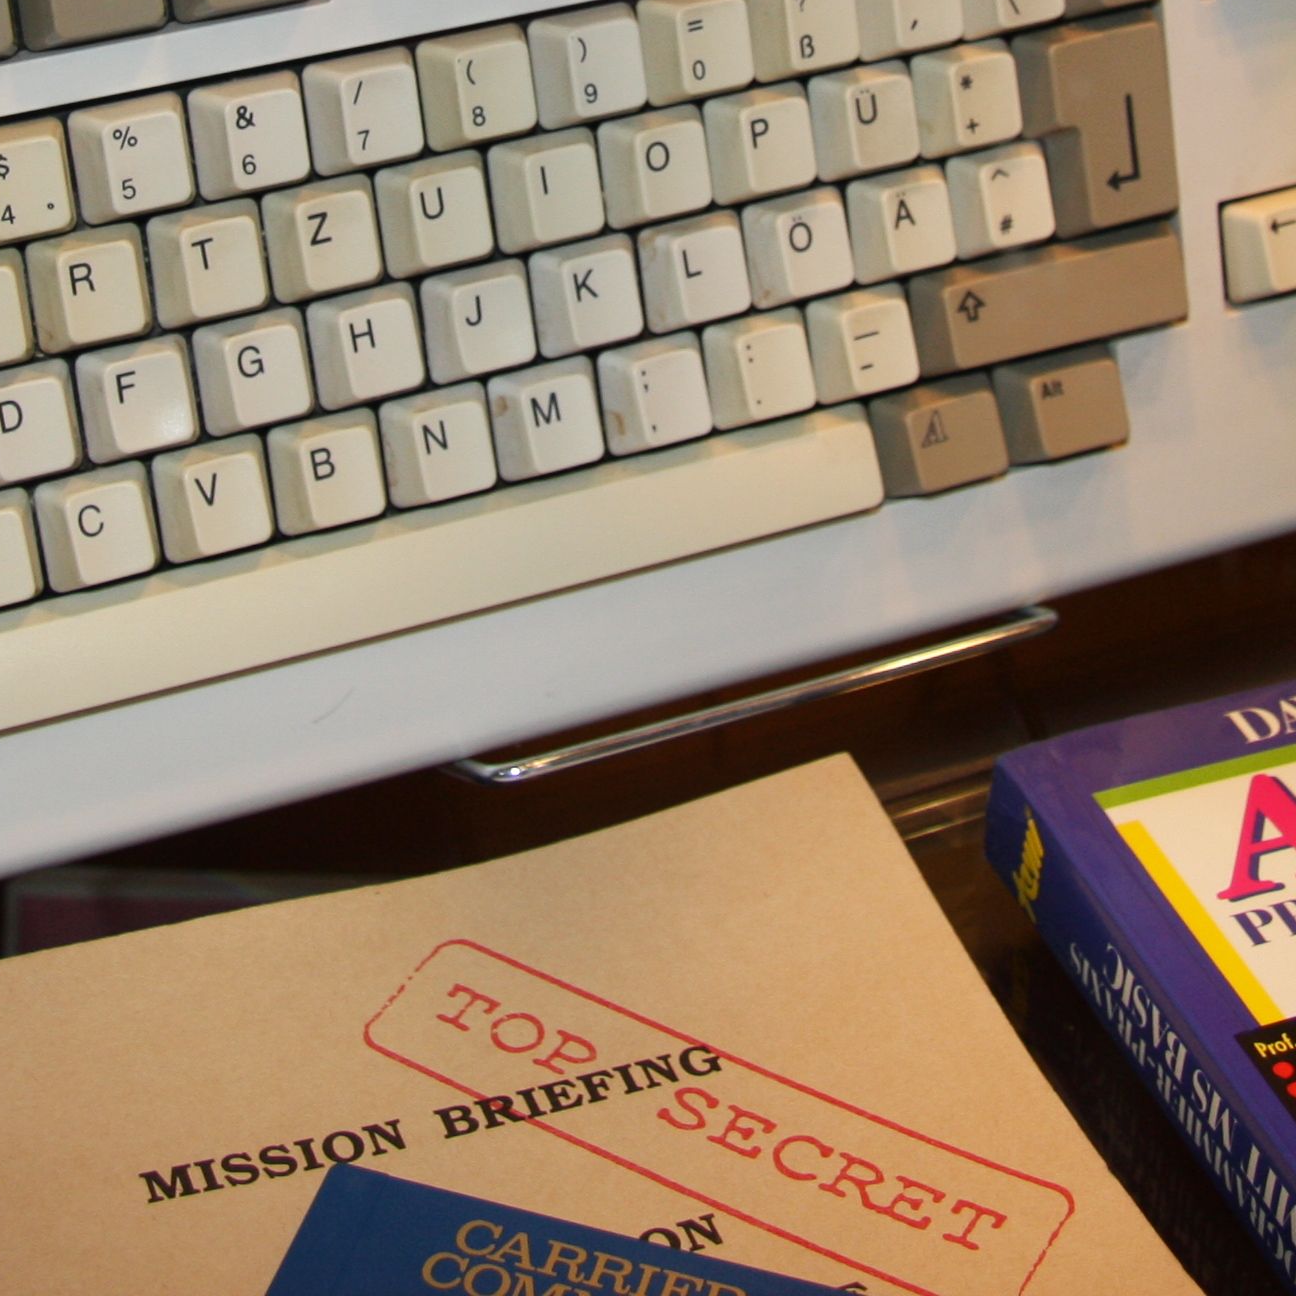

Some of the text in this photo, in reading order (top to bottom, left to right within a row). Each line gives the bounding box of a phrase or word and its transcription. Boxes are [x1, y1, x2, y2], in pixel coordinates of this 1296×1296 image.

[799, 35, 815, 59] ß
[692, 59, 706, 81] 0
[584, 83, 599, 104] 9
[855, 89, 878, 125] Ü
[472, 106, 487, 127] 8
[357, 129, 371, 152] 7
[750, 118, 770, 149] P
[241, 154, 257, 176] 6
[645, 141, 670, 172] O
[121, 178, 137, 201] 5
[420, 187, 444, 220] U
[0, 204, 17, 226] 4
[895, 191, 916, 230] Ä
[306, 212, 333, 247] Z
[789, 215, 813, 253] Ö
[191, 238, 215, 271] T
[682, 248, 703, 279] L
[68, 262, 96, 296] R
[572, 269, 599, 302] K
[465, 296, 482, 327] J
[349, 318, 377, 353] H
[237, 346, 265, 380] G
[115, 371, 137, 405] F
[1041, 380, 1065, 400] Alt
[530, 392, 562, 427] M
[422, 420, 449, 455] N
[309, 447, 337, 482] B
[194, 473, 218, 507] V
[77, 505, 105, 538] C
[436, 982, 598, 1076] TOP
[139, 1044, 724, 1205] MISSION BRIEFING
[656, 1086, 1008, 1252] SECRET
